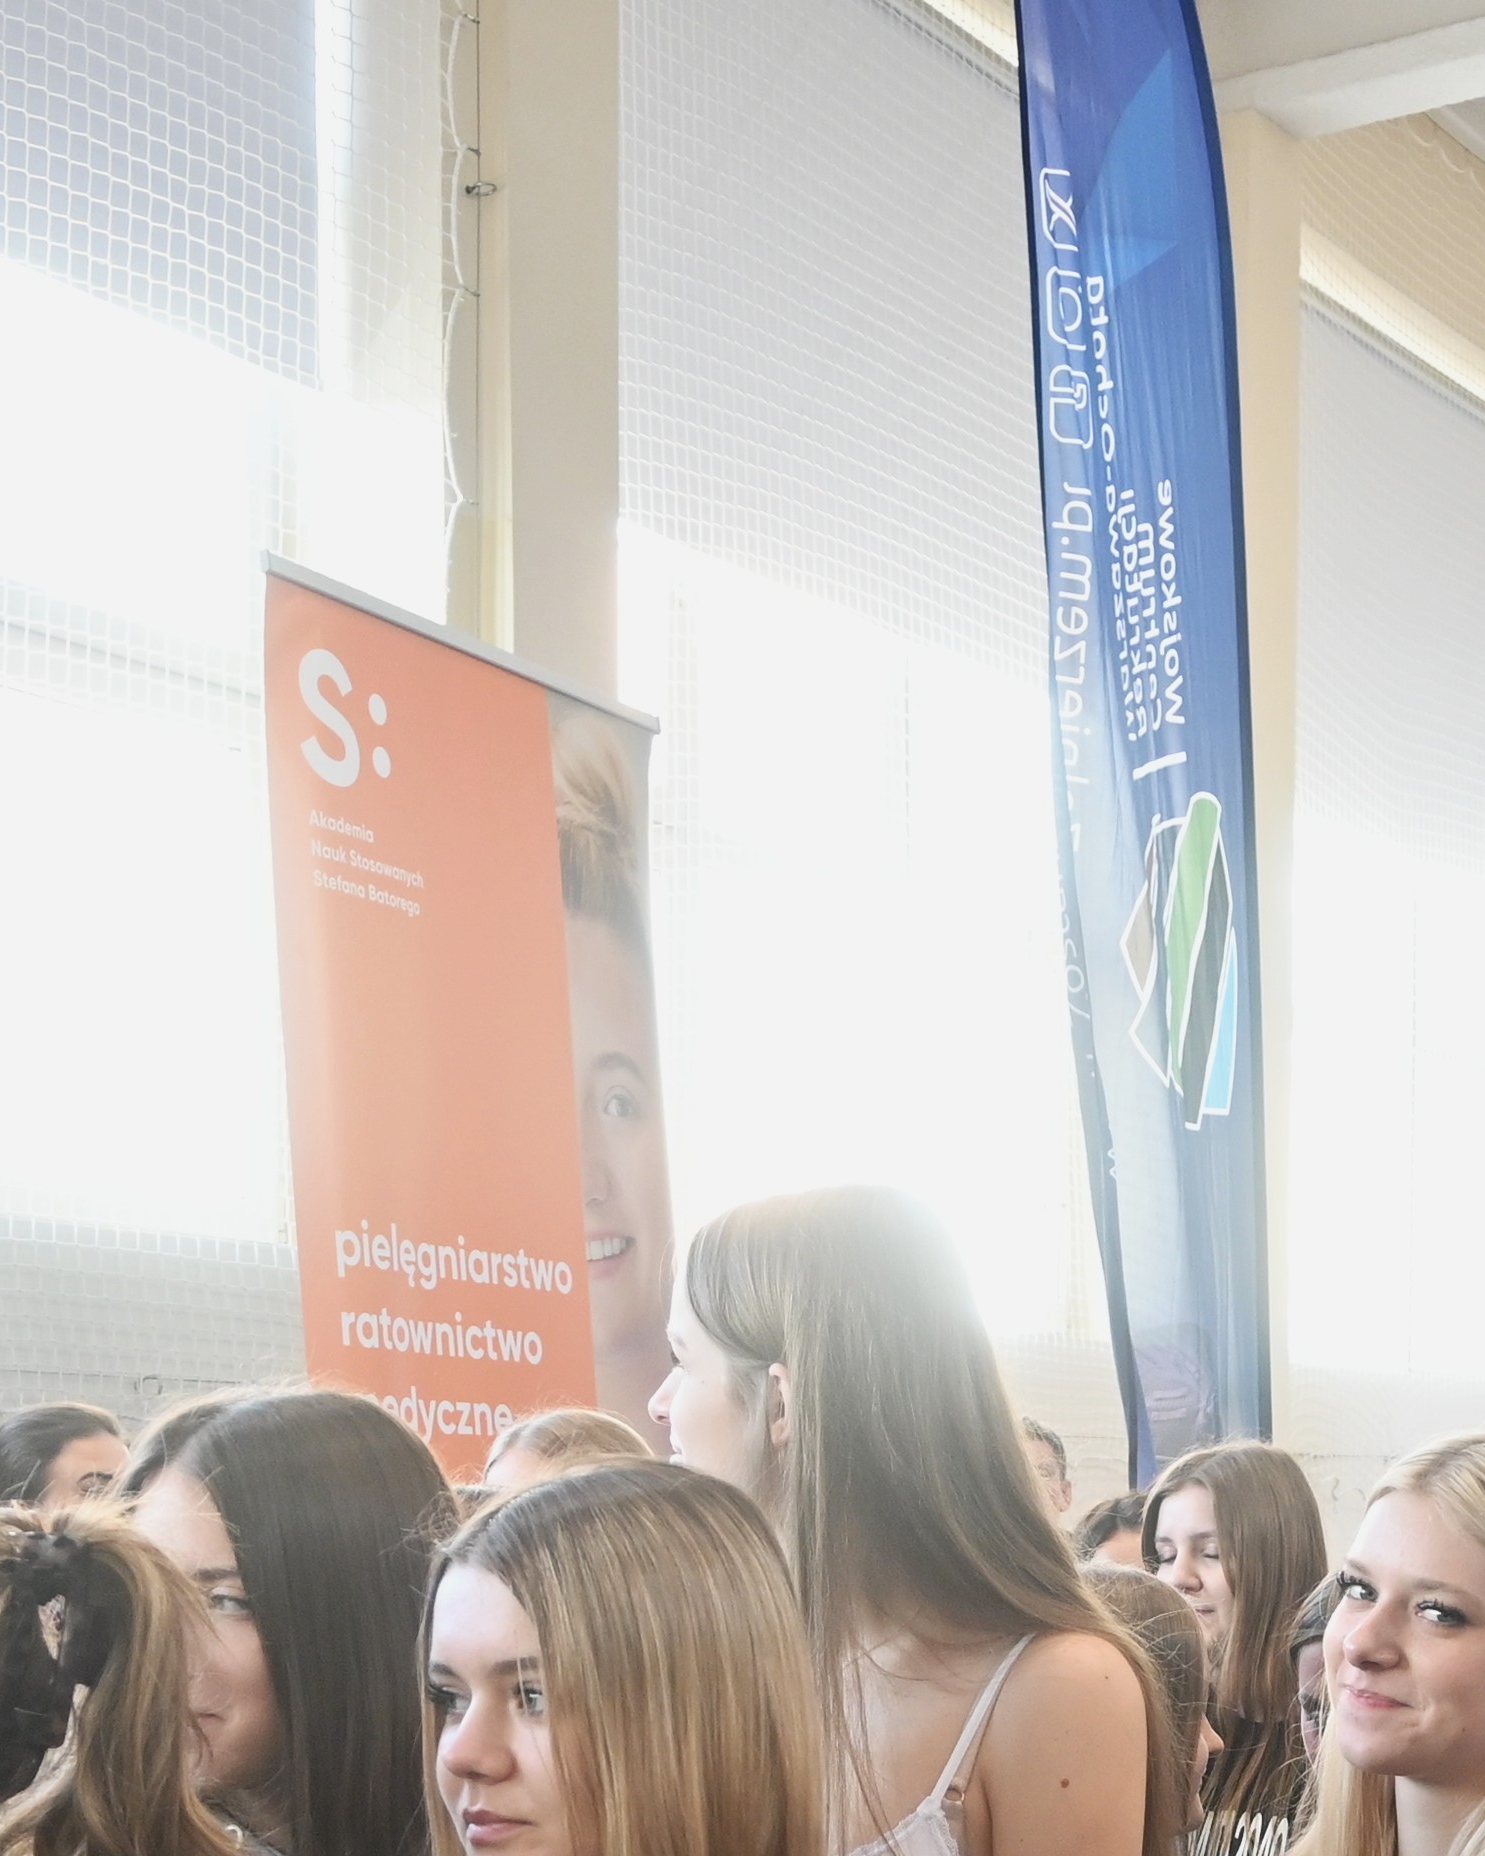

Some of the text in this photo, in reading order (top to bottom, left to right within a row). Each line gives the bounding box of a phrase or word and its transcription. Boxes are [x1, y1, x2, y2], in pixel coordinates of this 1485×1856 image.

[310, 809, 375, 843] Akademia
[311, 840, 424, 888] Nauk Stosowanych
[313, 869, 420, 917] Stefana Batorego
[334, 1219, 574, 1295] pielęgniarstwo
[340, 1307, 544, 1366] ratownictwo
[365, 1385, 514, 1444] edyczne
